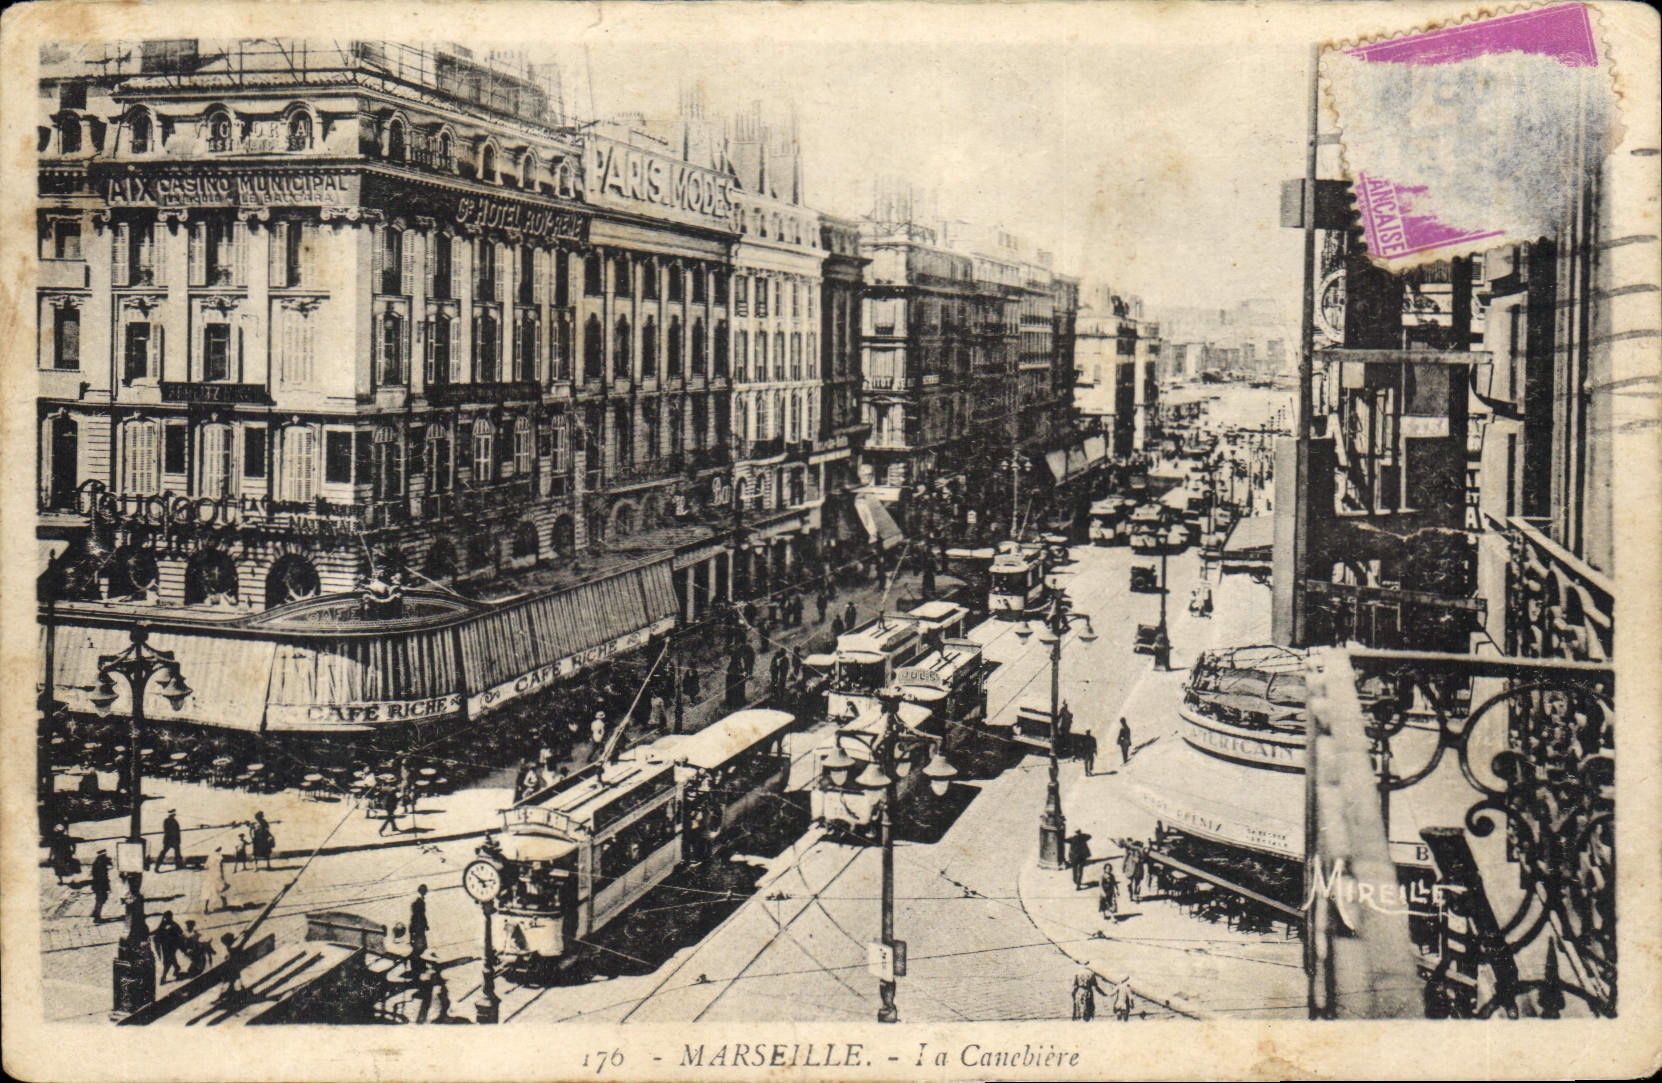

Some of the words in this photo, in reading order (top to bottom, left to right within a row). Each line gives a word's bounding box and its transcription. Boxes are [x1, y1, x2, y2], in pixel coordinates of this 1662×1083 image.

[107, 176, 155, 206] AIX
[157, 177, 231, 195] CASINO
[237, 174, 349, 194] MUNICIPAL
[585, 145, 665, 204] PARIS
[668, 163, 733, 219] MODES
[475, 198, 521, 231] HOTEL
[513, 662, 564, 693] CAFE
[574, 638, 618, 667] RICHE
[306, 703, 378, 723] CAFE
[386, 696, 447, 720] RICHE
